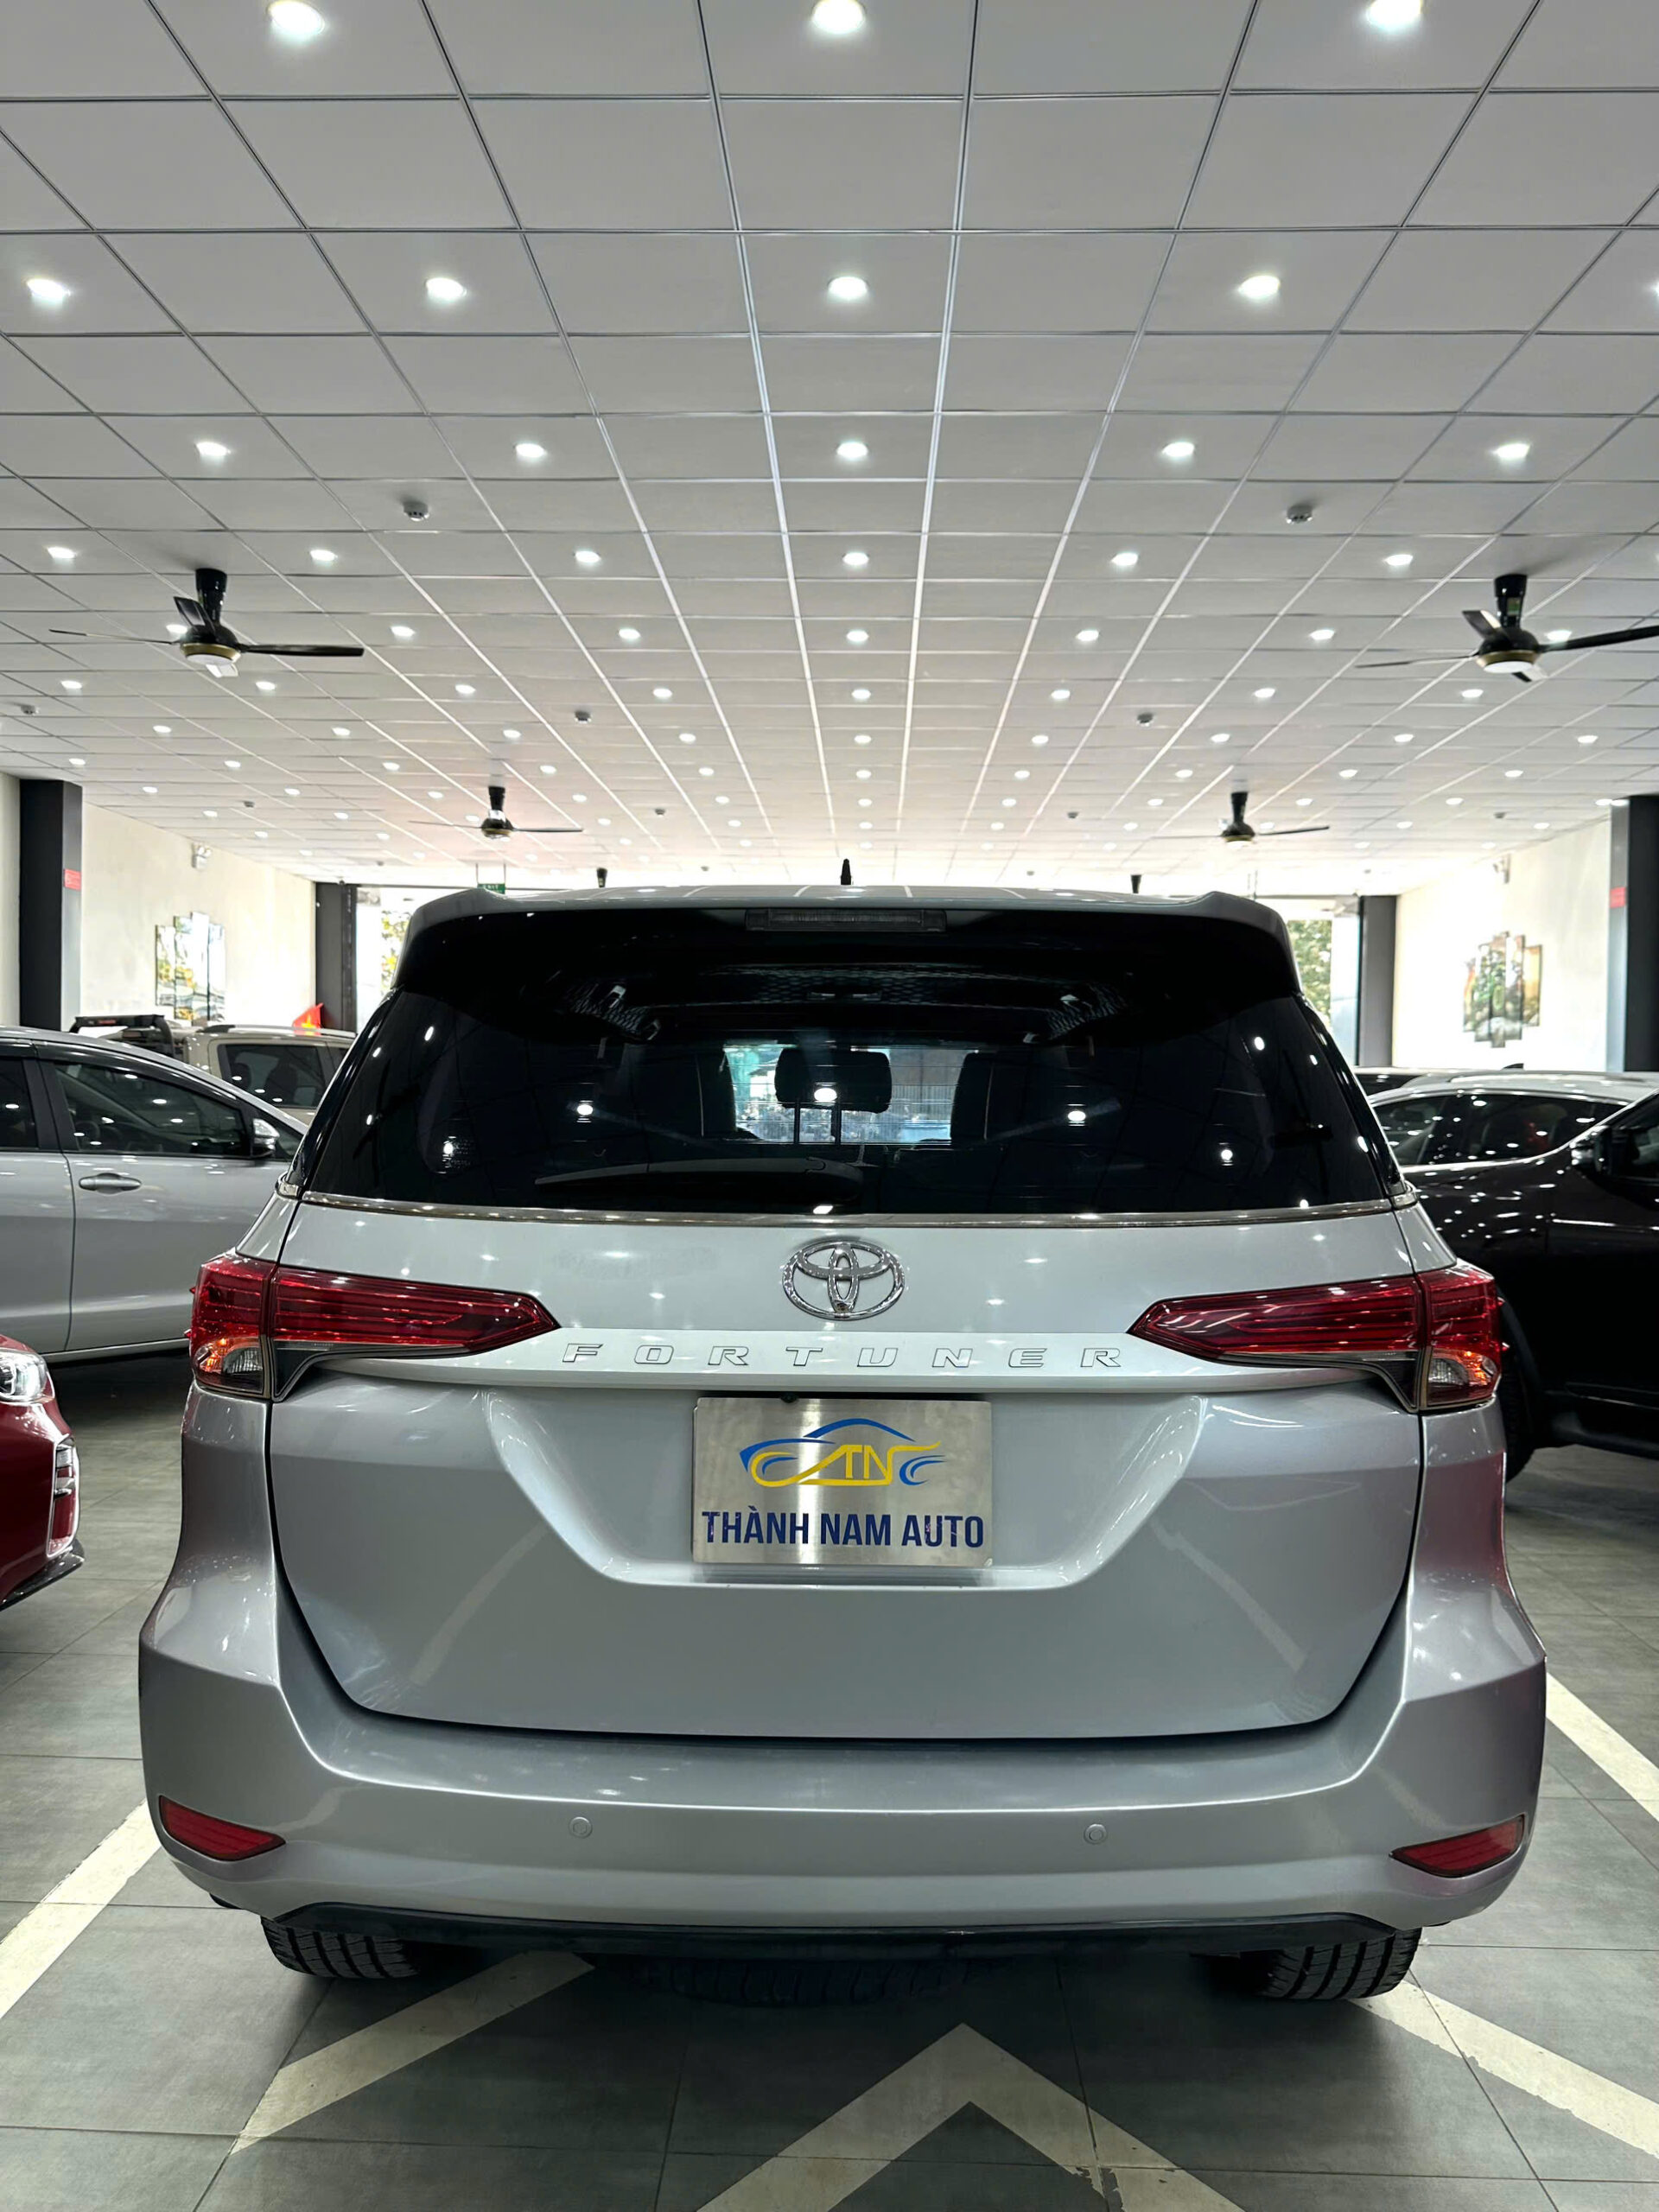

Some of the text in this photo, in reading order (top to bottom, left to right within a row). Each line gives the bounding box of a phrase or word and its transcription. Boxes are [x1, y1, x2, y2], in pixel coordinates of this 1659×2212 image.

[562, 1343, 1122, 1368] FORTUNER
[702, 1505, 983, 1548] THÀNH NAM AUTO
